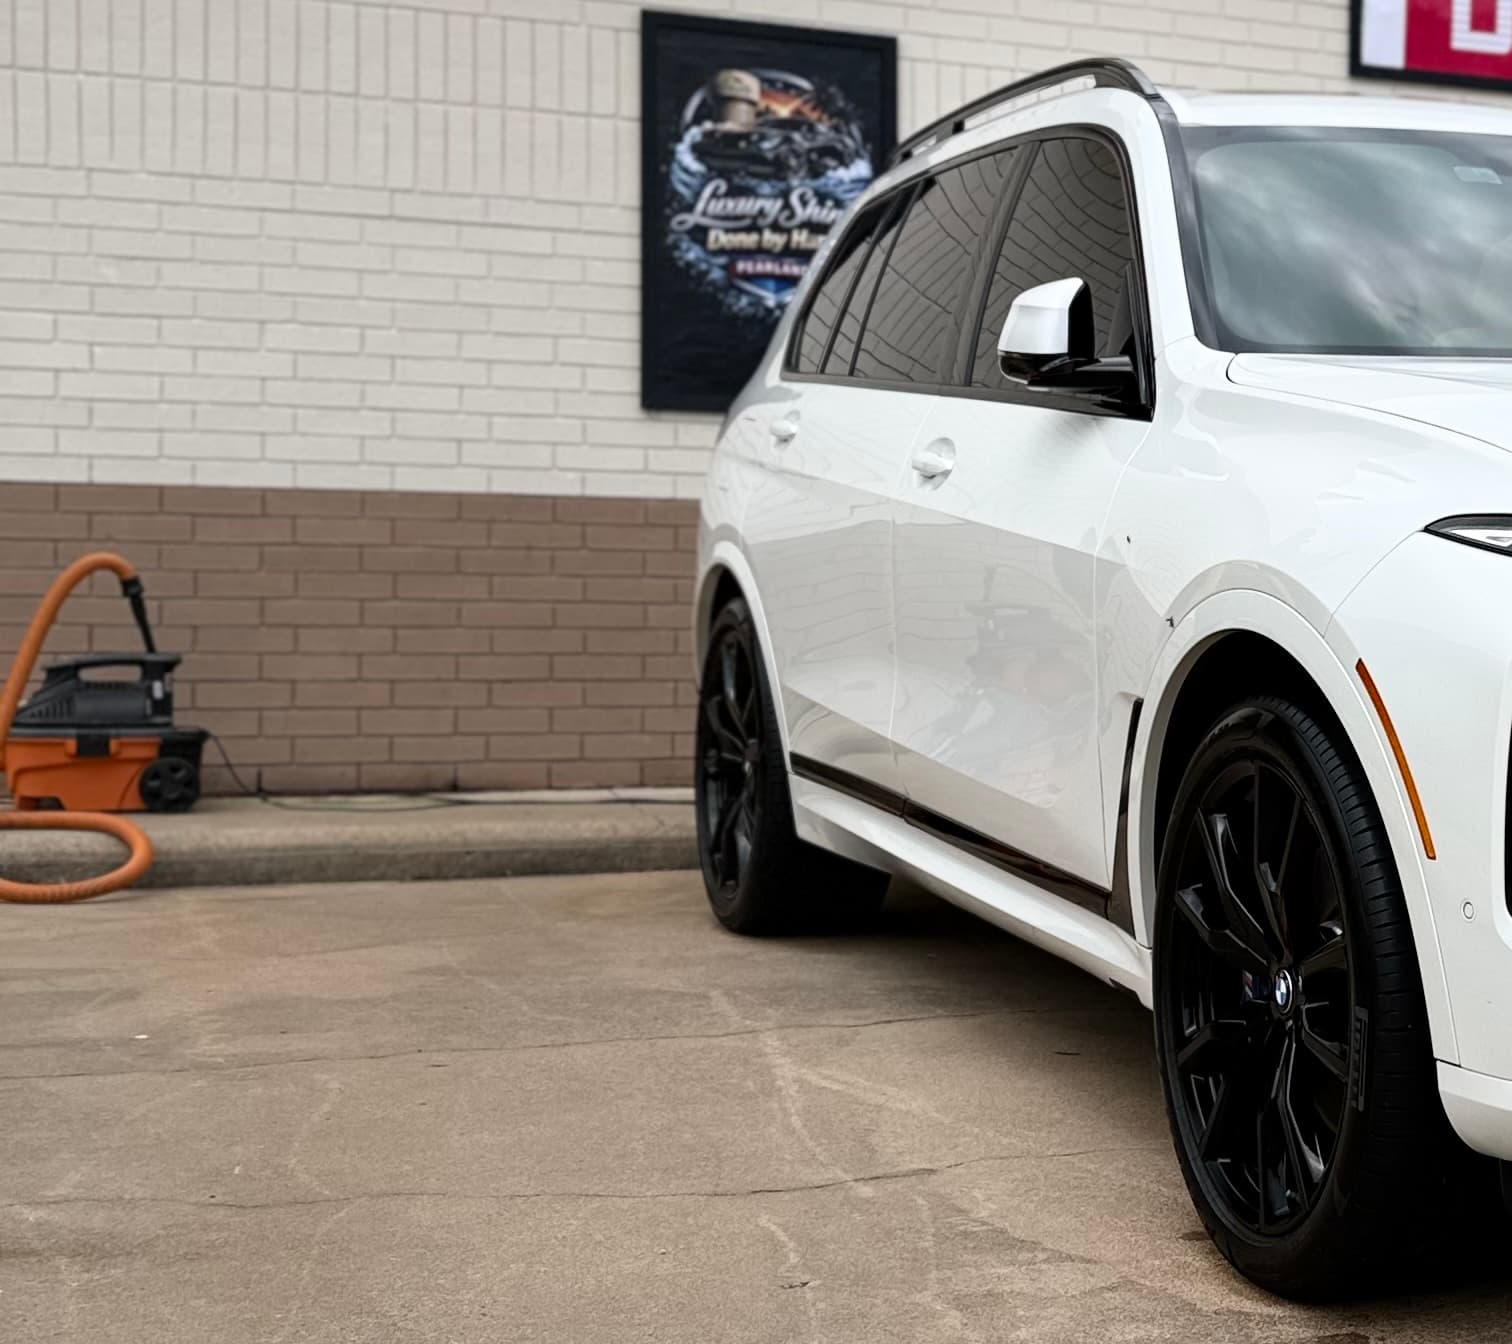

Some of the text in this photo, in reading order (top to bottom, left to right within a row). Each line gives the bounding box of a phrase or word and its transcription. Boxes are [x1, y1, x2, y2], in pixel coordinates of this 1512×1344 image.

[671, 178, 844, 232] Luxury Shin
[706, 227, 759, 251] Done
[761, 226, 788, 254] by
